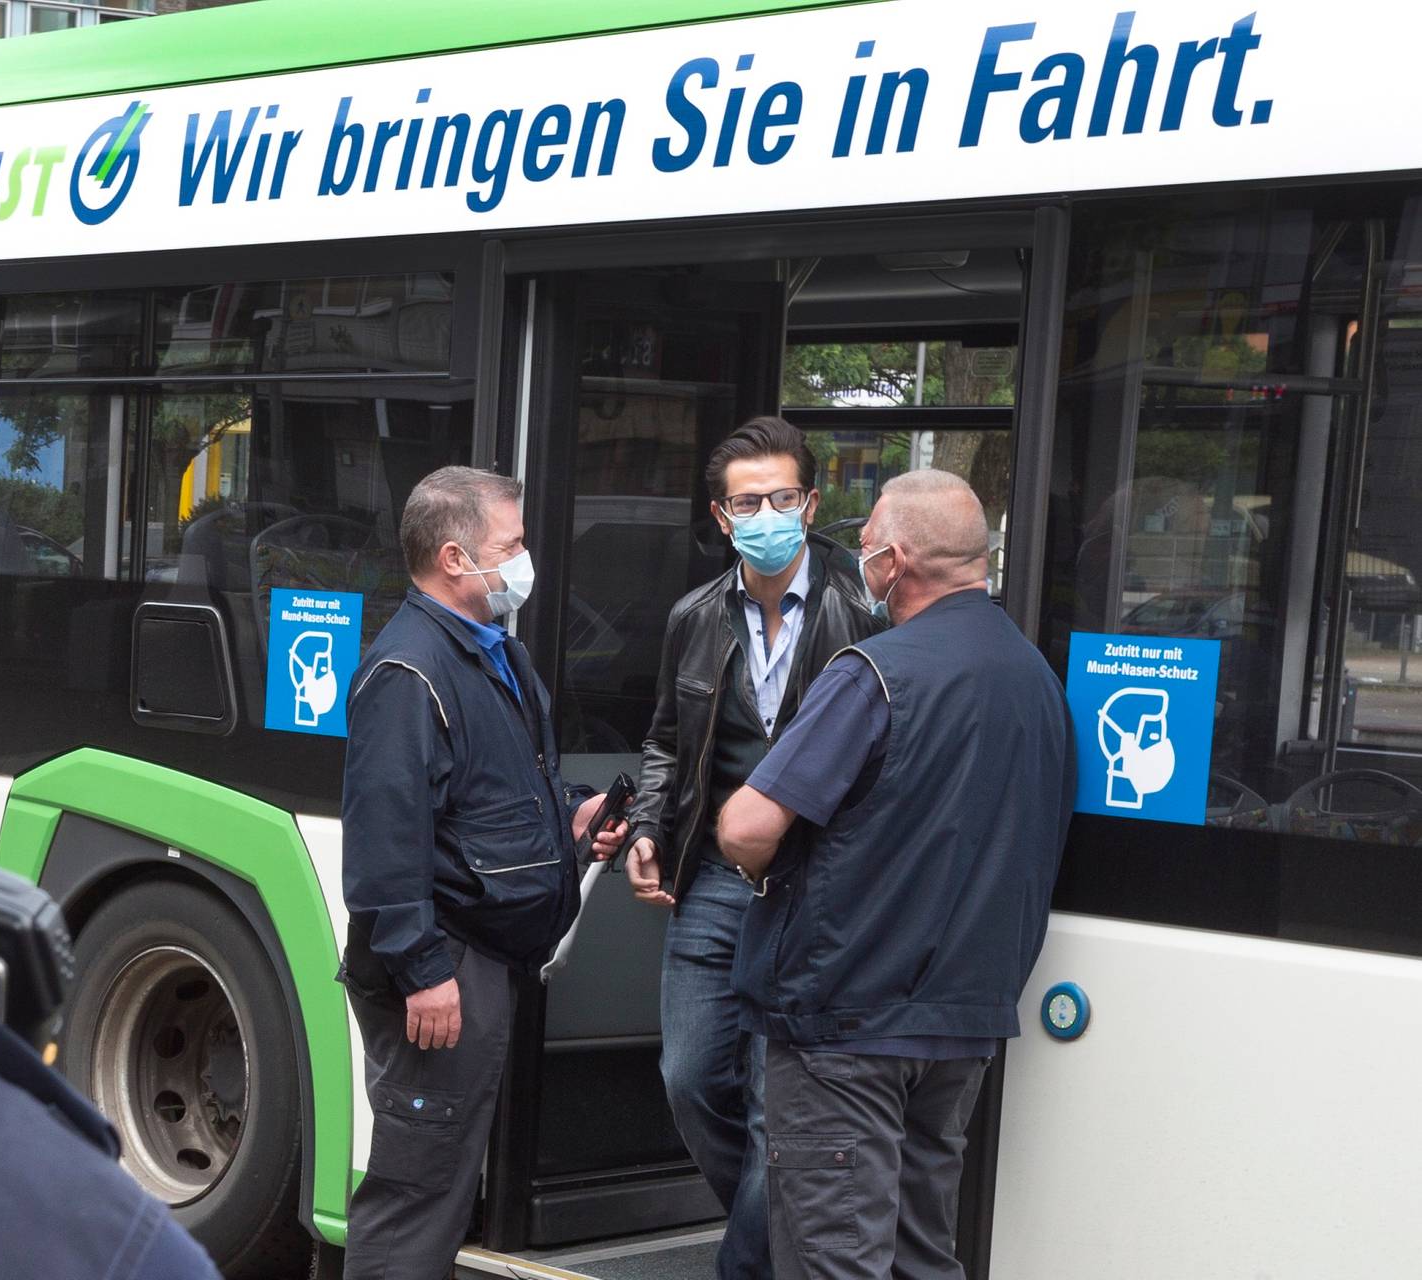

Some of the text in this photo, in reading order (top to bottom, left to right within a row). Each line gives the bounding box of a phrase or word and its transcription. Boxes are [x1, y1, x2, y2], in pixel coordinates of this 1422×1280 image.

[178, 11, 1274, 213] Wir bringen Sie in Fahrt.
[292, 596, 341, 610] Zutritt nur mit
[281, 610, 351, 625] Mund-Nasen-Schutz
[1104, 643, 1183, 661] Zutritt nur mit
[1086, 660, 1199, 681] Mund-Nasen-Schutz
